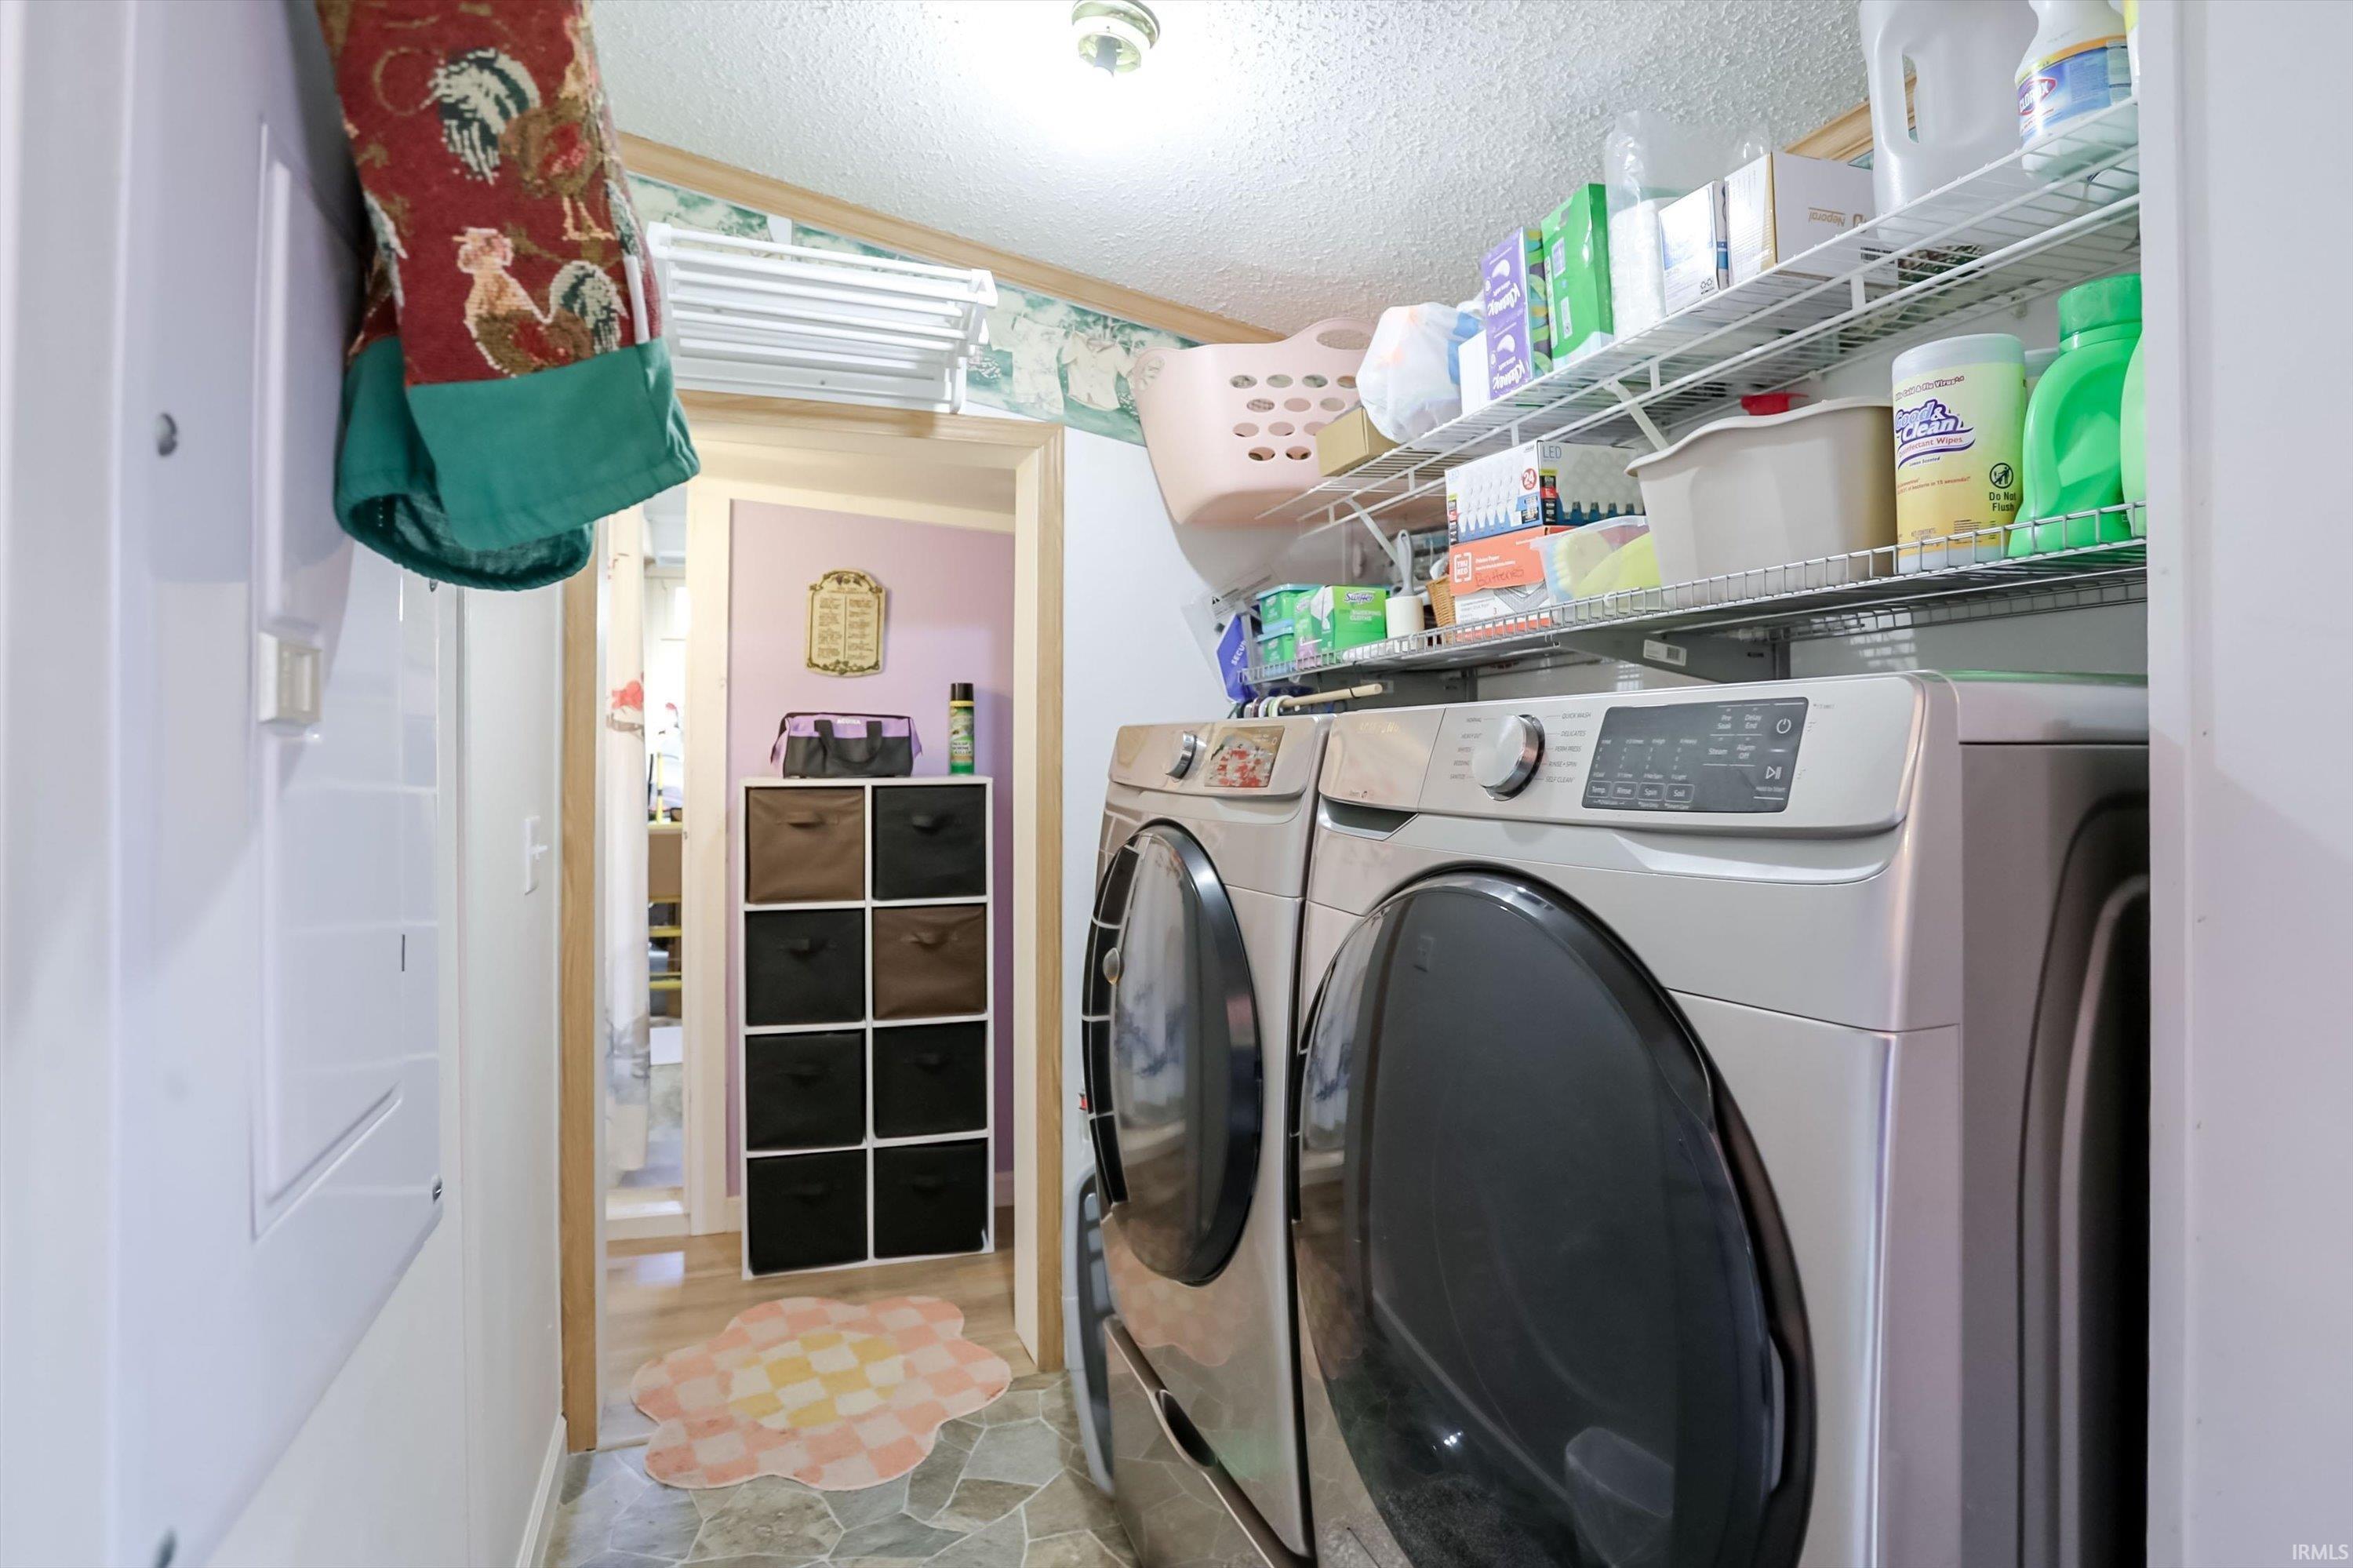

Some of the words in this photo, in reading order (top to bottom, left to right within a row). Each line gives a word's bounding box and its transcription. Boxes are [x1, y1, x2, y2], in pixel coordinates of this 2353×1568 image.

[1487, 282, 1521, 316] Kleenex
[1493, 359, 1526, 390] Kleenex
[1896, 399, 1936, 431] Good
[1930, 406, 1945, 421] &
[1902, 417, 1955, 440] Clean
[1936, 437, 1963, 446] Wipes
[1542, 445, 1562, 460] LED
[1523, 470, 1535, 486] 24
[1989, 492, 2002, 501] Do
[2003, 492, 2017, 501] Not
[1992, 502, 2015, 511] Flush
[1344, 591, 1375, 605] Swiffer
[1591, 786, 1606, 795] Temp
[1617, 787, 1632, 795] Rinse
[1644, 788, 1658, 797] Spin
[1674, 789, 1686, 798] Soil
